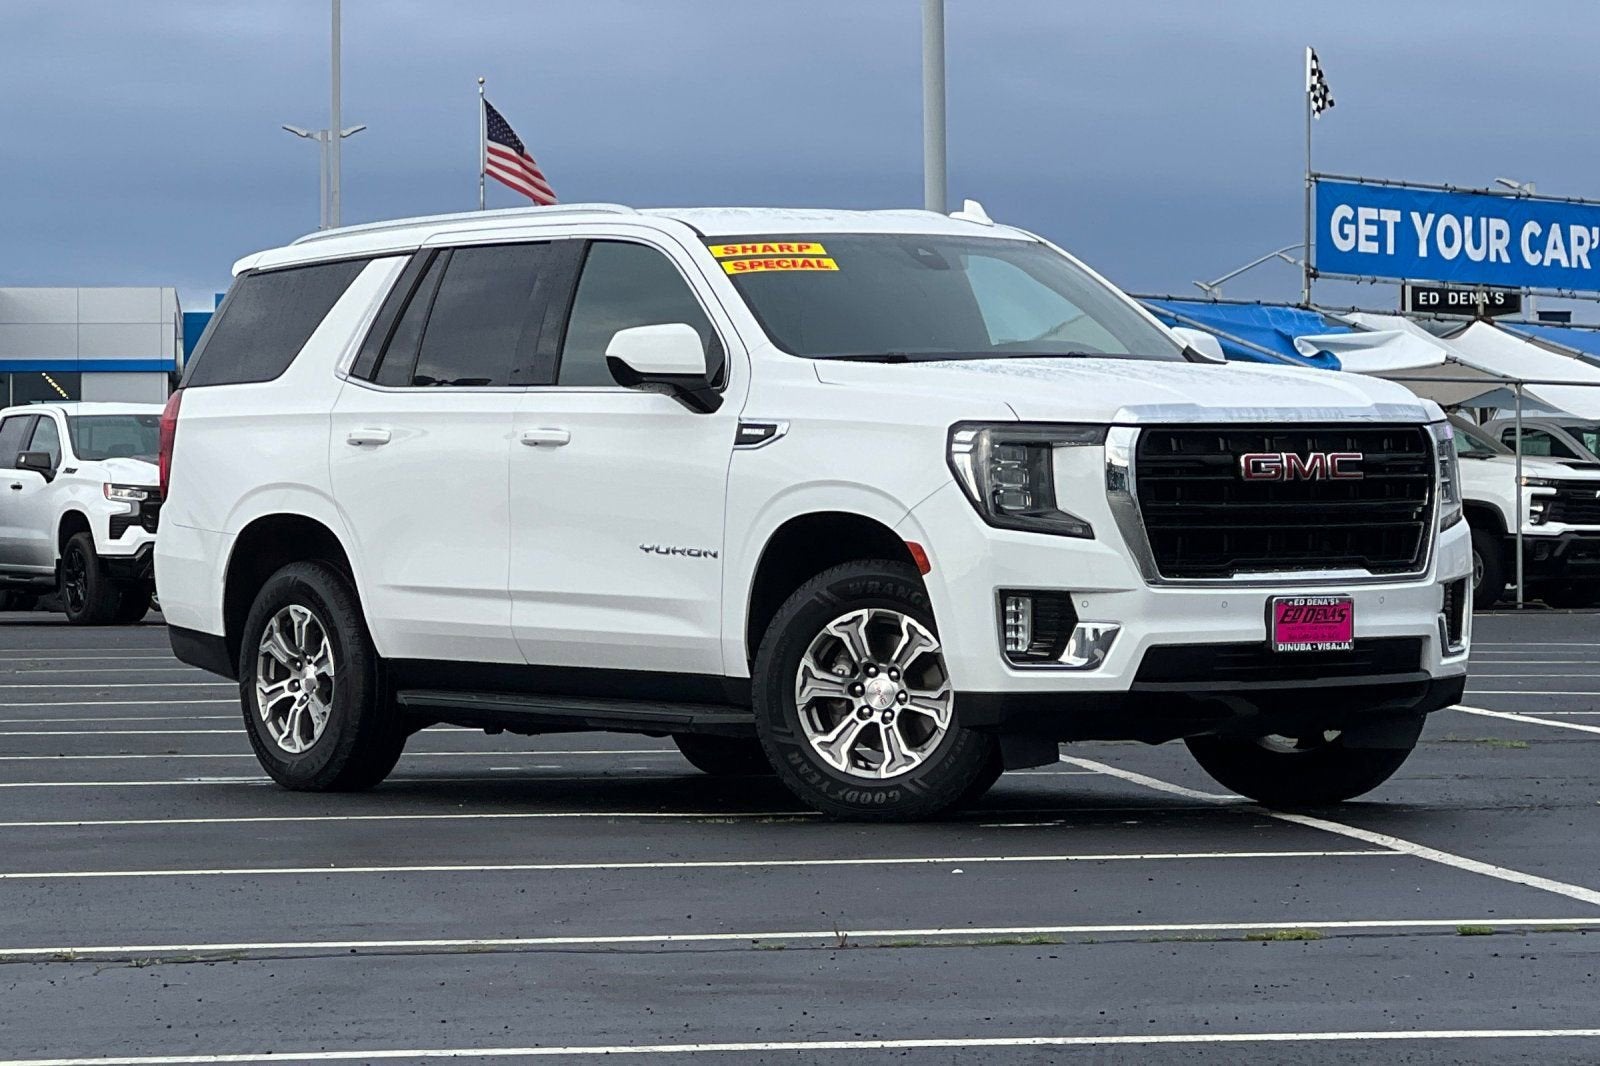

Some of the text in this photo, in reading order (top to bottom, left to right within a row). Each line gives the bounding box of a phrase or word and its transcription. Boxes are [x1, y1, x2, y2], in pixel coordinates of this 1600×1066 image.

[1330, 204, 1401, 255] GET
[1410, 211, 1511, 264] YOUR
[723, 243, 811, 255] SHARP
[732, 259, 830, 271] SPECIAL
[1419, 291, 1505, 305] ED DENA'S
[1240, 452, 1363, 481] GMC
[639, 543, 718, 559] YUKON
[1294, 598, 1335, 606] ED DENA'S
[1278, 608, 1304, 624] ED
[1278, 642, 1350, 652] DINUBA VISALIA
